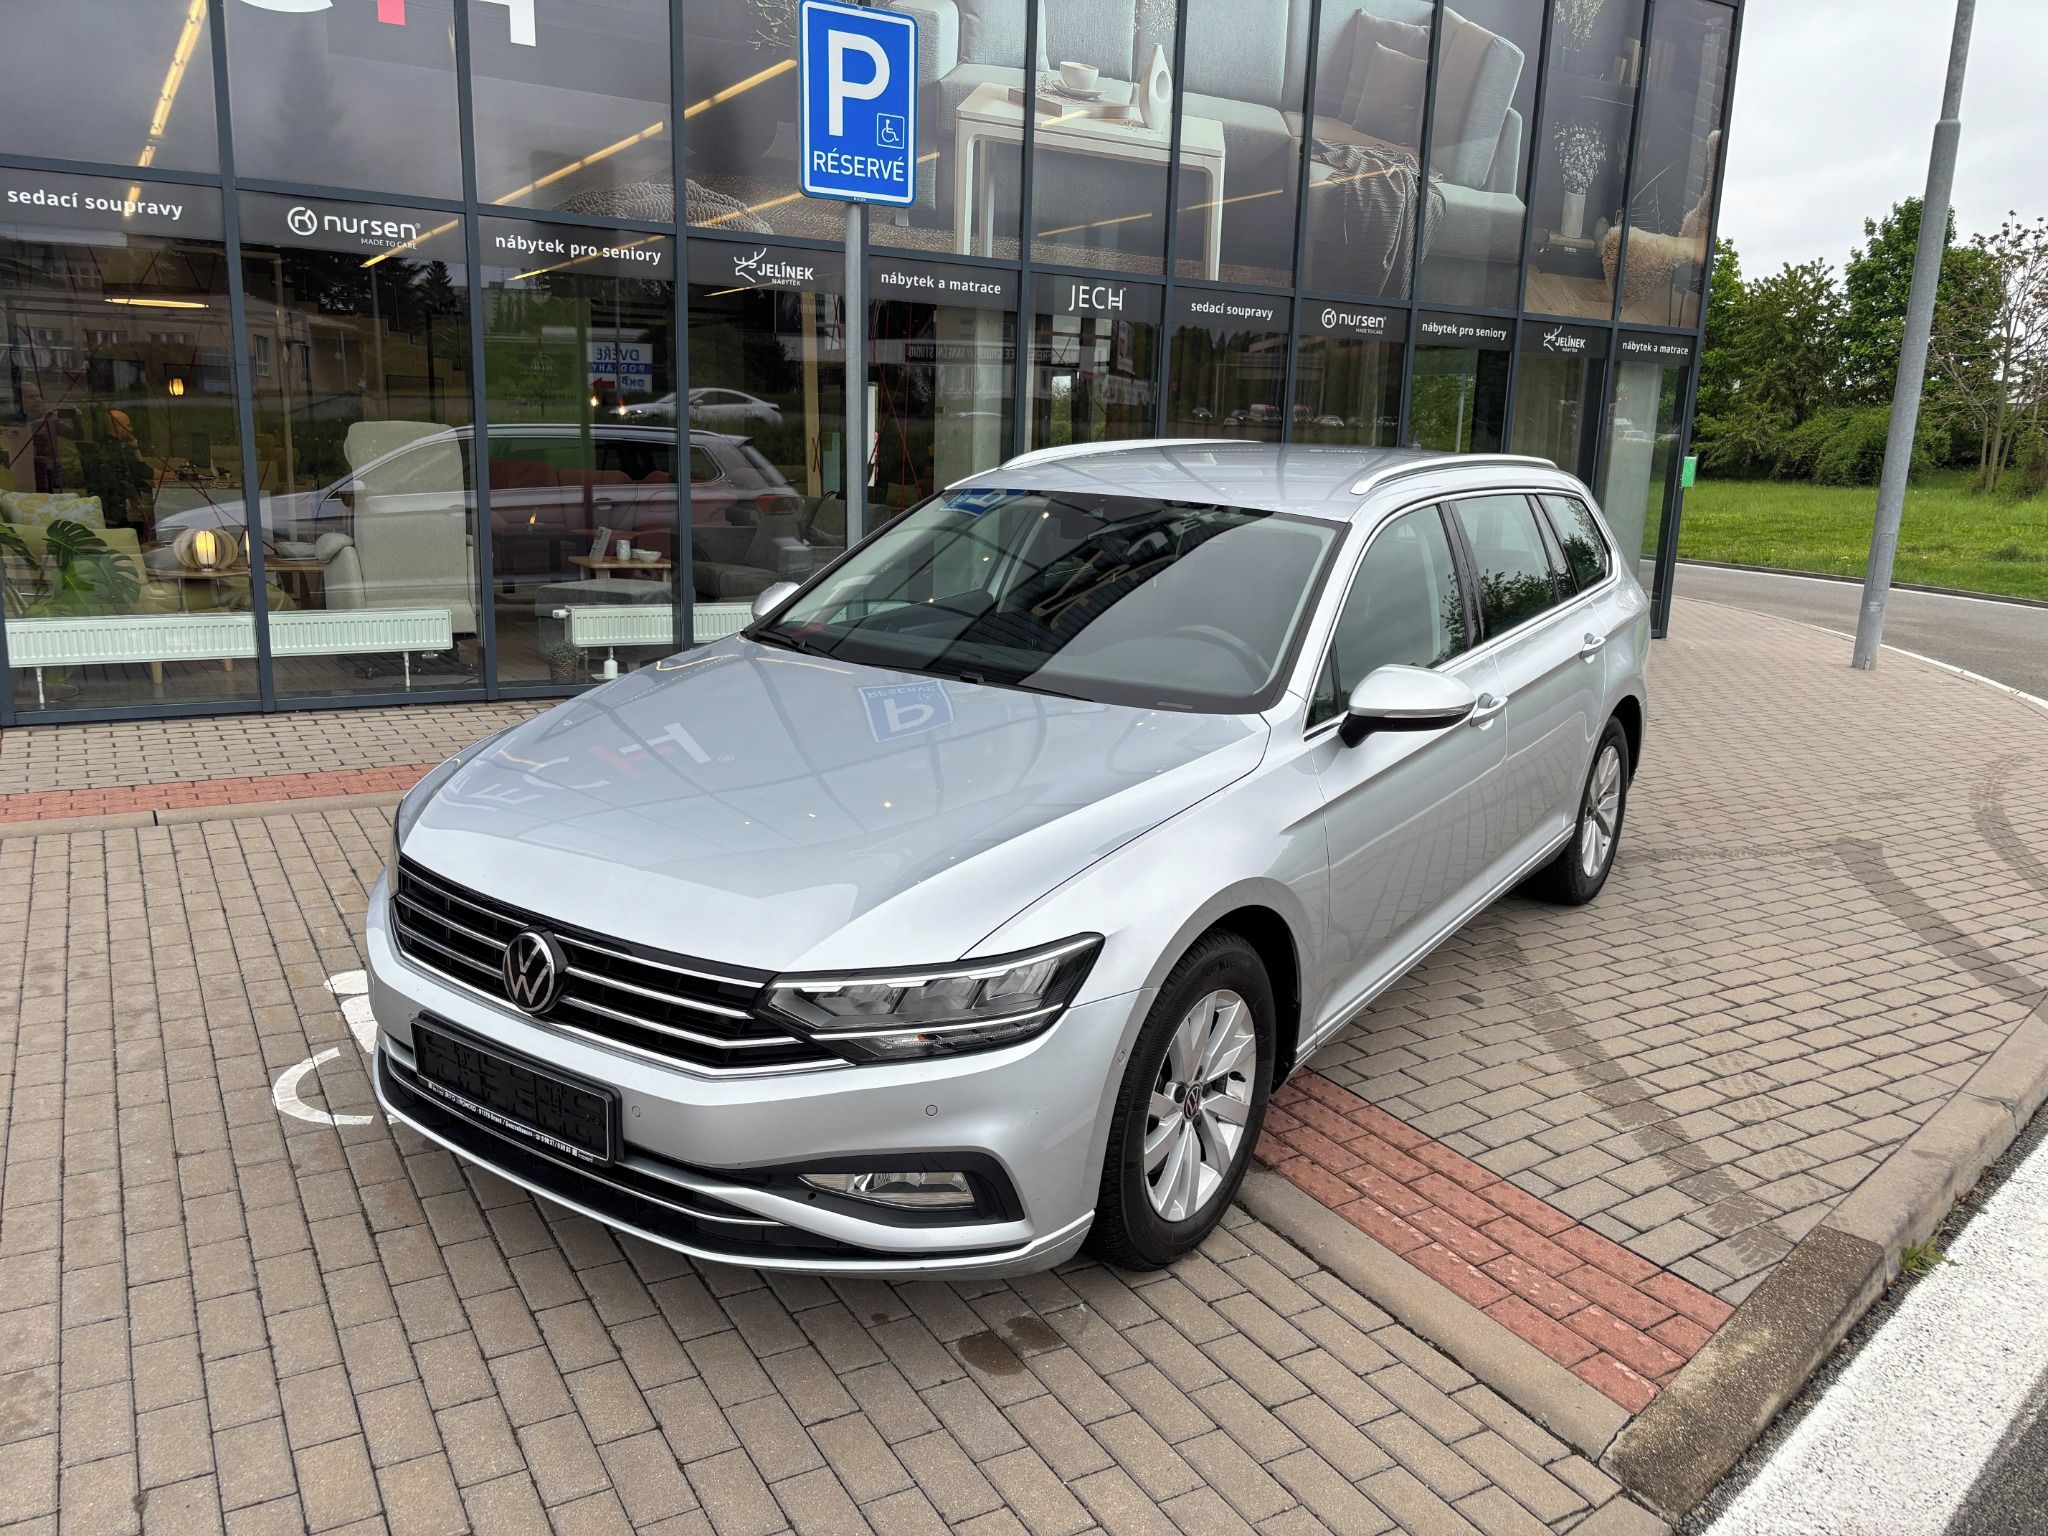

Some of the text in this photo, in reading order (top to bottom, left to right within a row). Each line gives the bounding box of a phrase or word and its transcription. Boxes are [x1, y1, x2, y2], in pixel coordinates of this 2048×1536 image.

[827, 28, 891, 137] P
[813, 147, 905, 182] RÉSERVÉ
[7, 189, 183, 221] sedací soupravy
[360, 237, 418, 250] MADE TO CARE
[495, 234, 662, 266] nábytek pro seniory
[756, 261, 815, 281] JELÍNEK
[880, 271, 1002, 295] nábytek a matrace
[1068, 284, 1124, 312] JECH
[1190, 301, 1274, 321] sedací soupravy
[1422, 321, 1507, 341] nábytek pro seniory
[1555, 335, 1586, 349] JELÍNEK
[1622, 340, 1689, 355] nábytek a matrace
